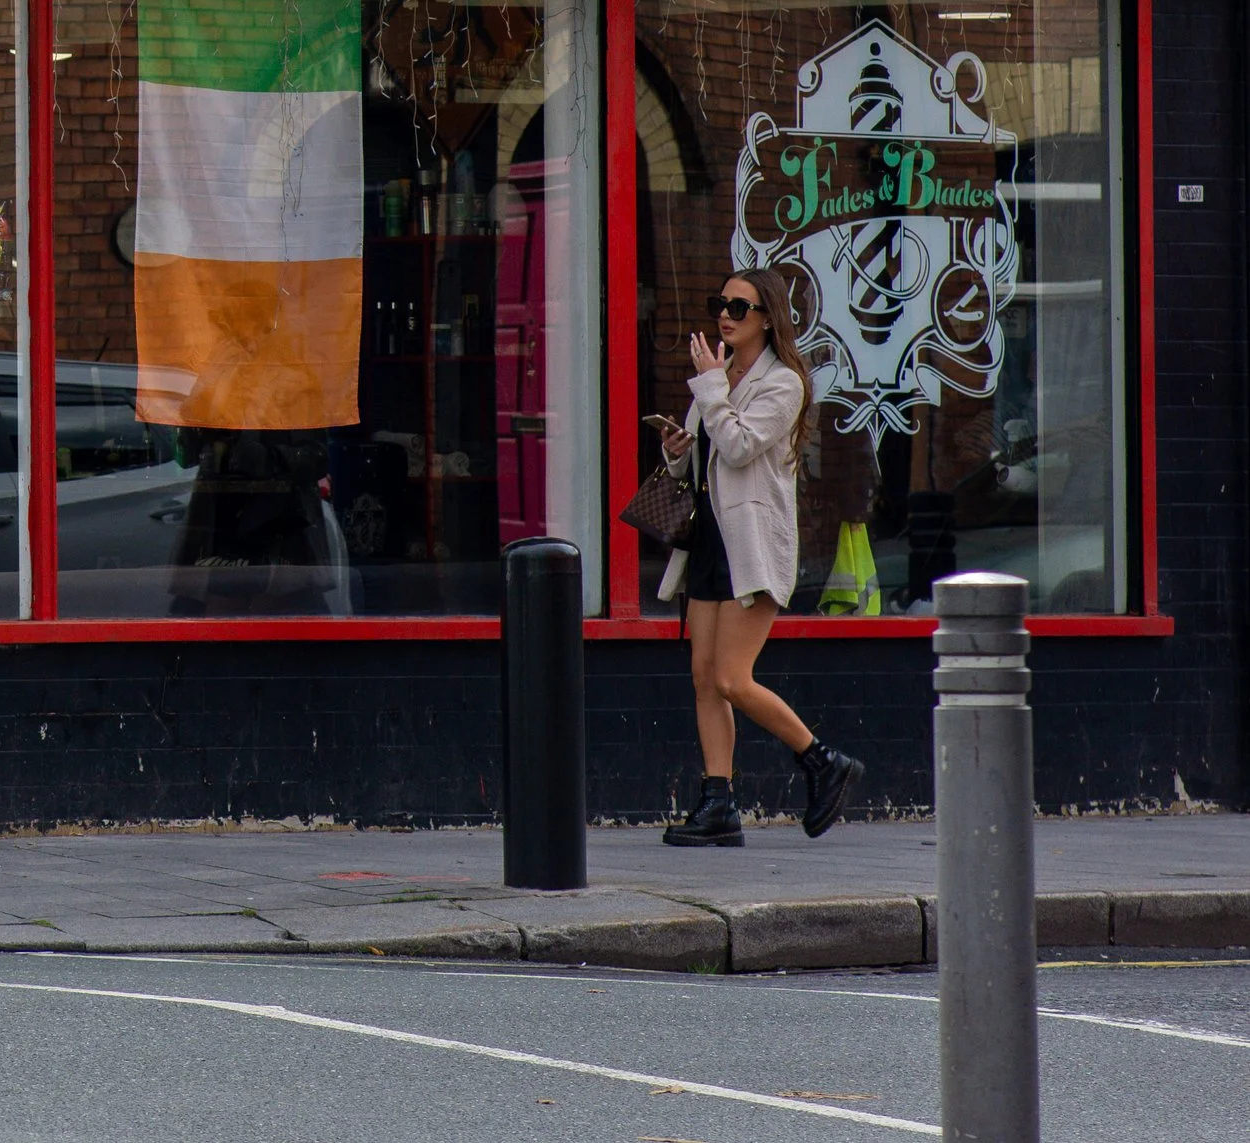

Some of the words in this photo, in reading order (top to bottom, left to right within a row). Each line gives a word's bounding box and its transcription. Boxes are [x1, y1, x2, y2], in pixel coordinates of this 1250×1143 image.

[775, 137, 875, 233] Fades
[878, 173, 894, 201] &
[883, 140, 995, 209] Blades
